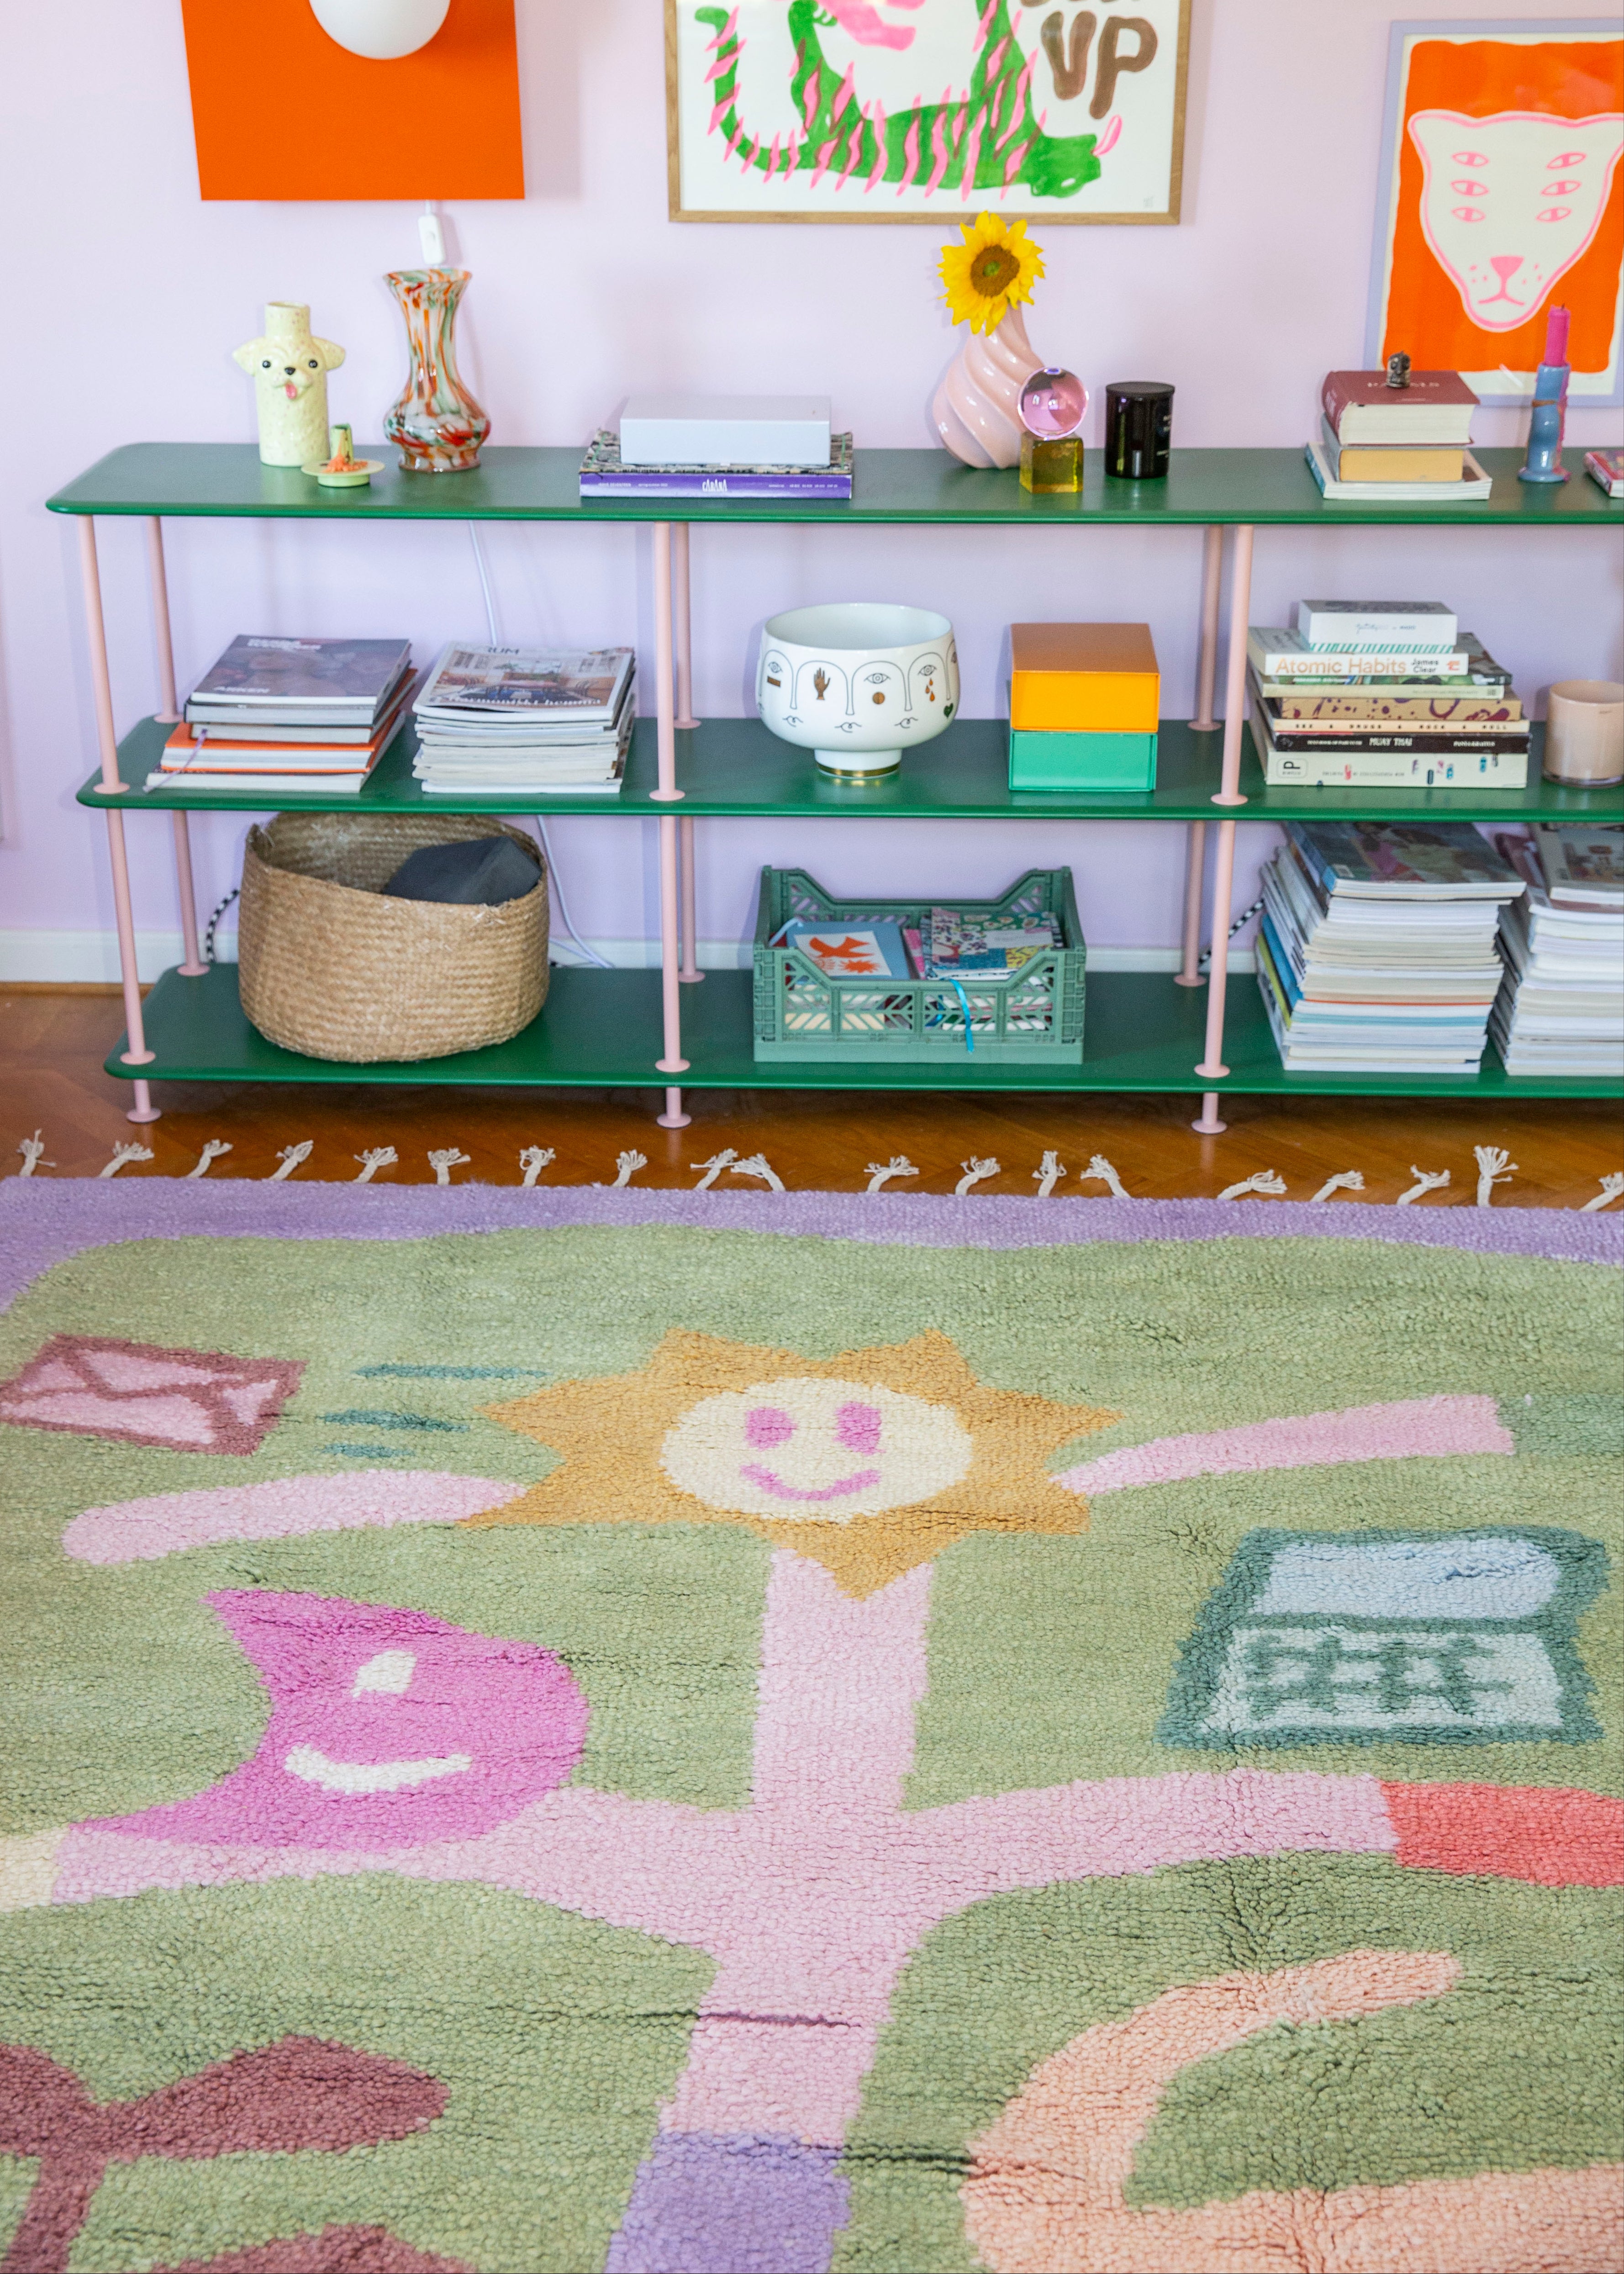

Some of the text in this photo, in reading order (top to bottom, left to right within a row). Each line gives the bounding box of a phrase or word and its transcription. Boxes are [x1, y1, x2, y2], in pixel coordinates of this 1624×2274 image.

[1276, 658, 1406, 674] Atomic Habits
[1369, 737, 1392, 746] MUAY
[1393, 738, 1413, 747] THAI
